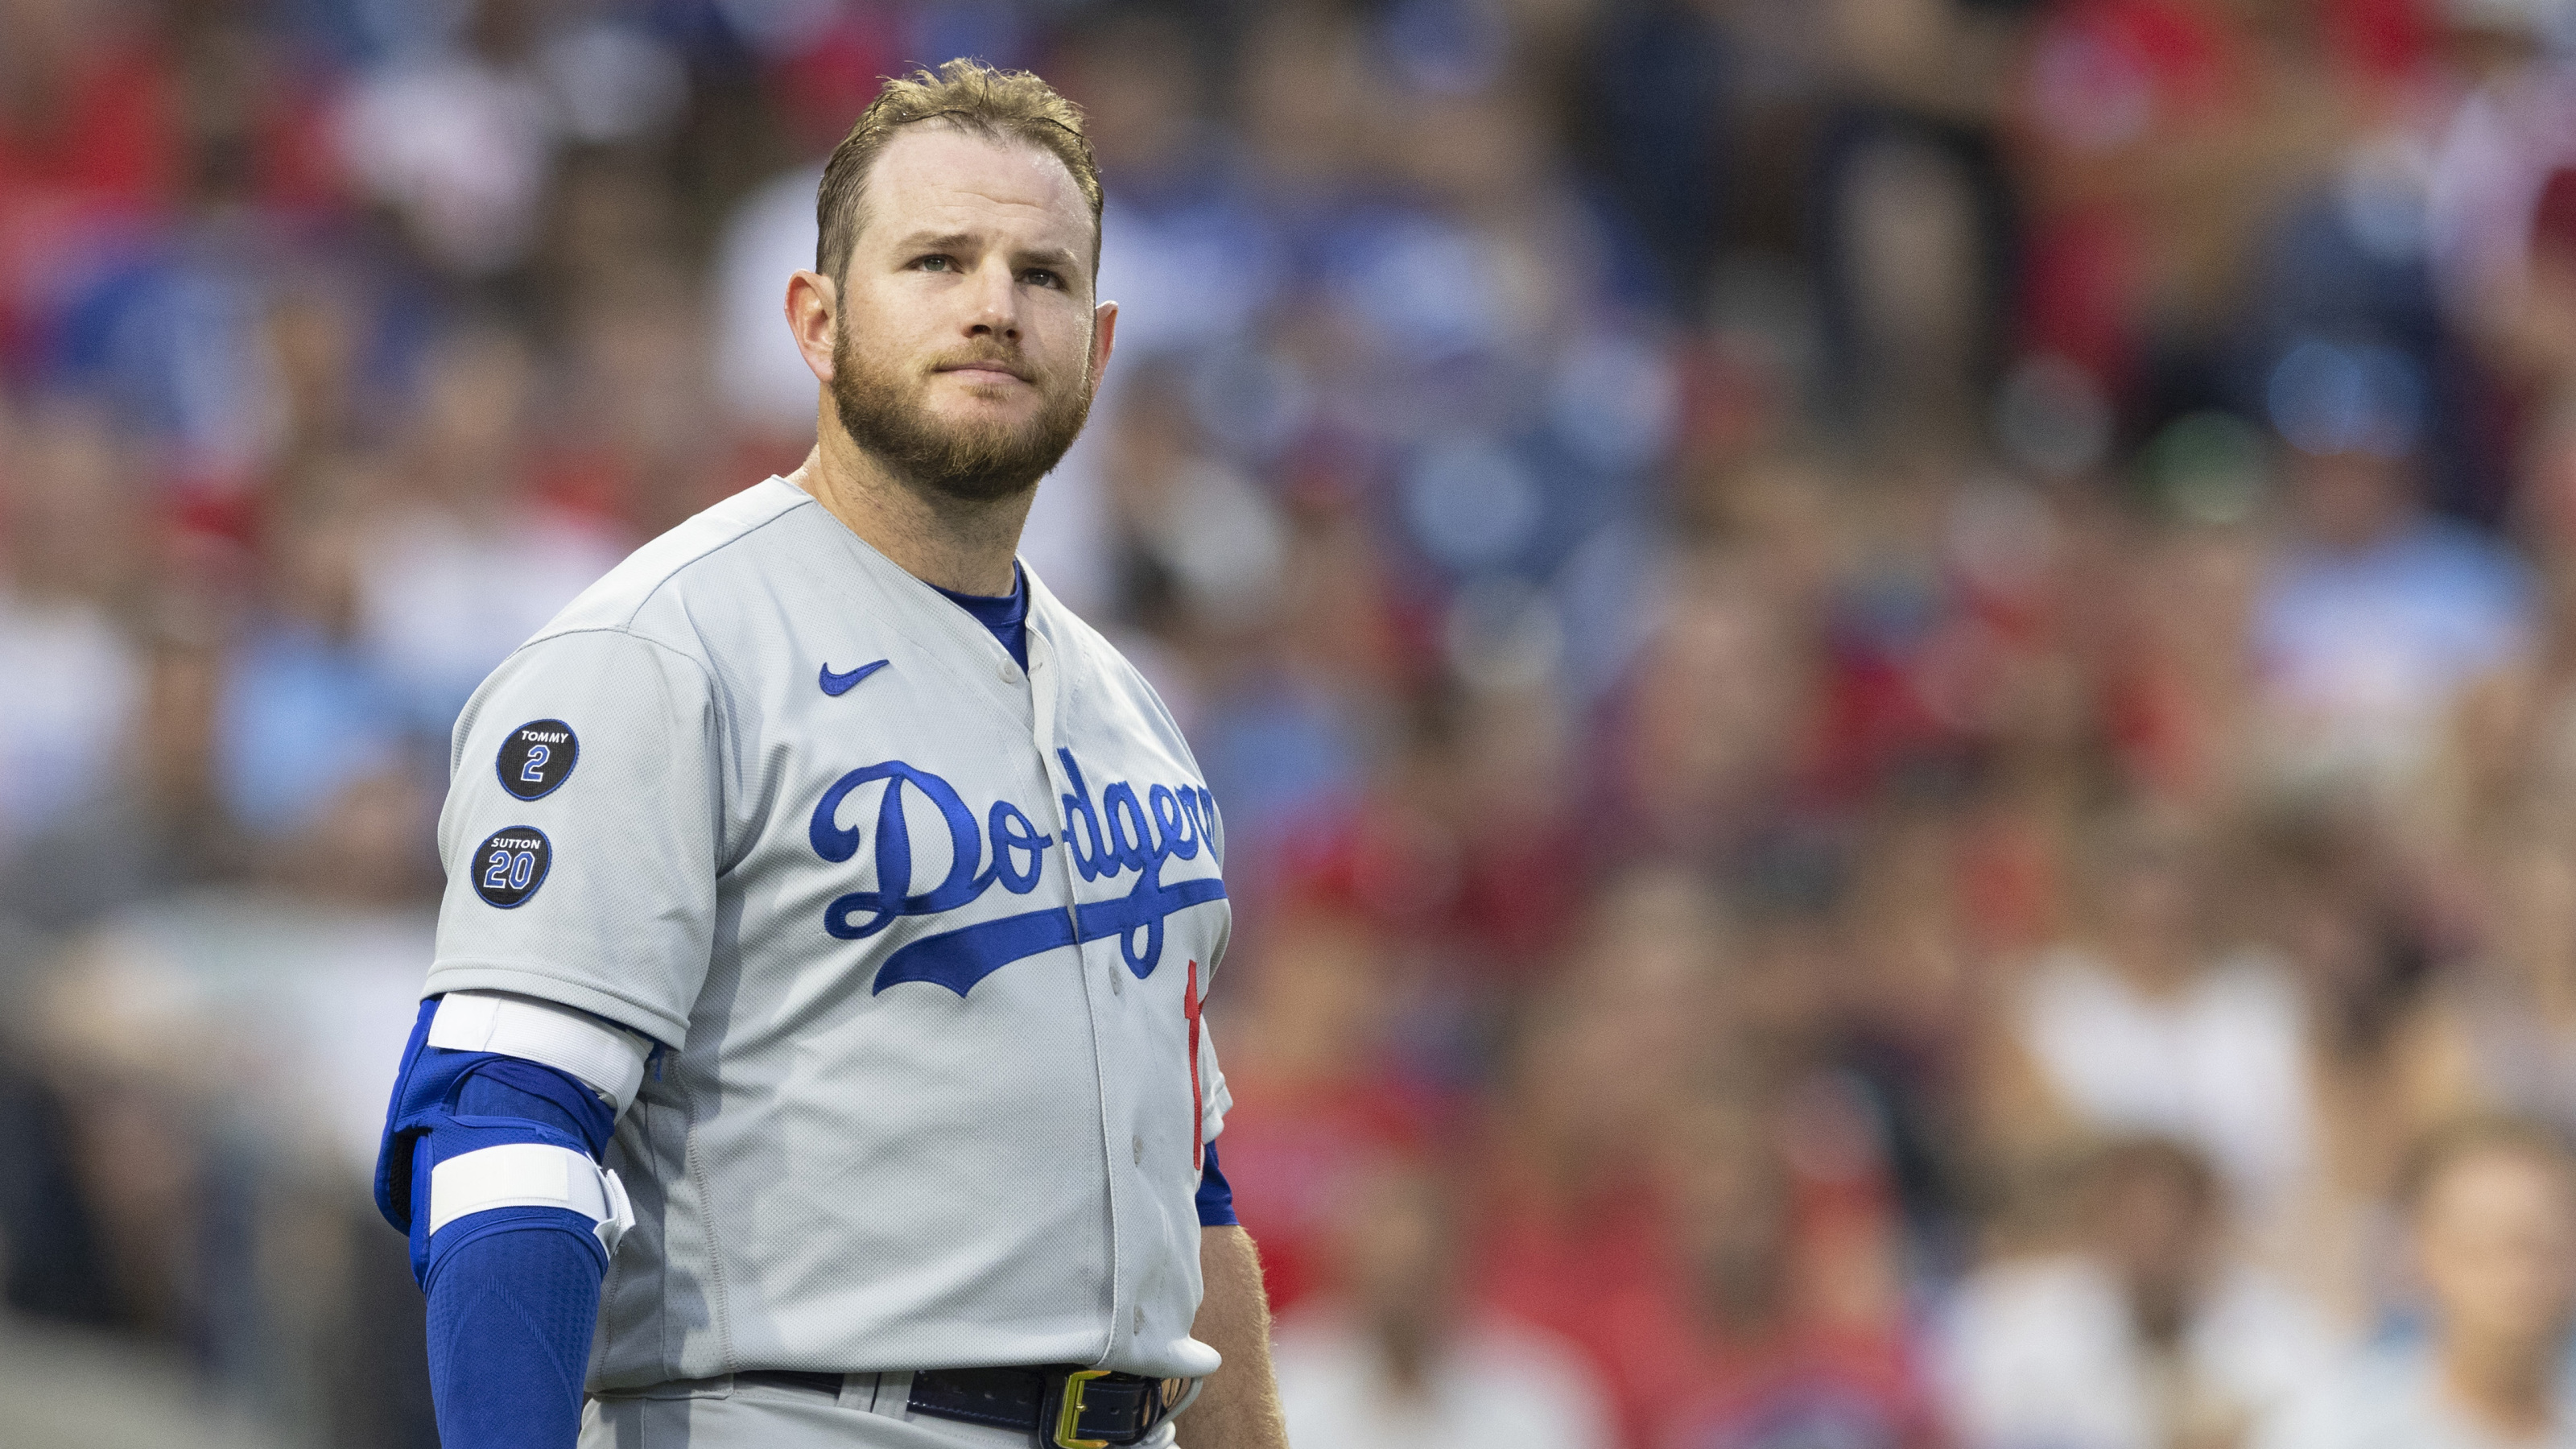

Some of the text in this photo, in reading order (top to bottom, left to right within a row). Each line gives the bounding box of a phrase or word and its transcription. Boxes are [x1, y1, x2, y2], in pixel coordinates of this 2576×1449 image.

[522, 730, 568, 744] TOMMY
[521, 745, 551, 782] 2
[491, 838, 541, 850] SUTTON
[483, 850, 535, 890] 20
